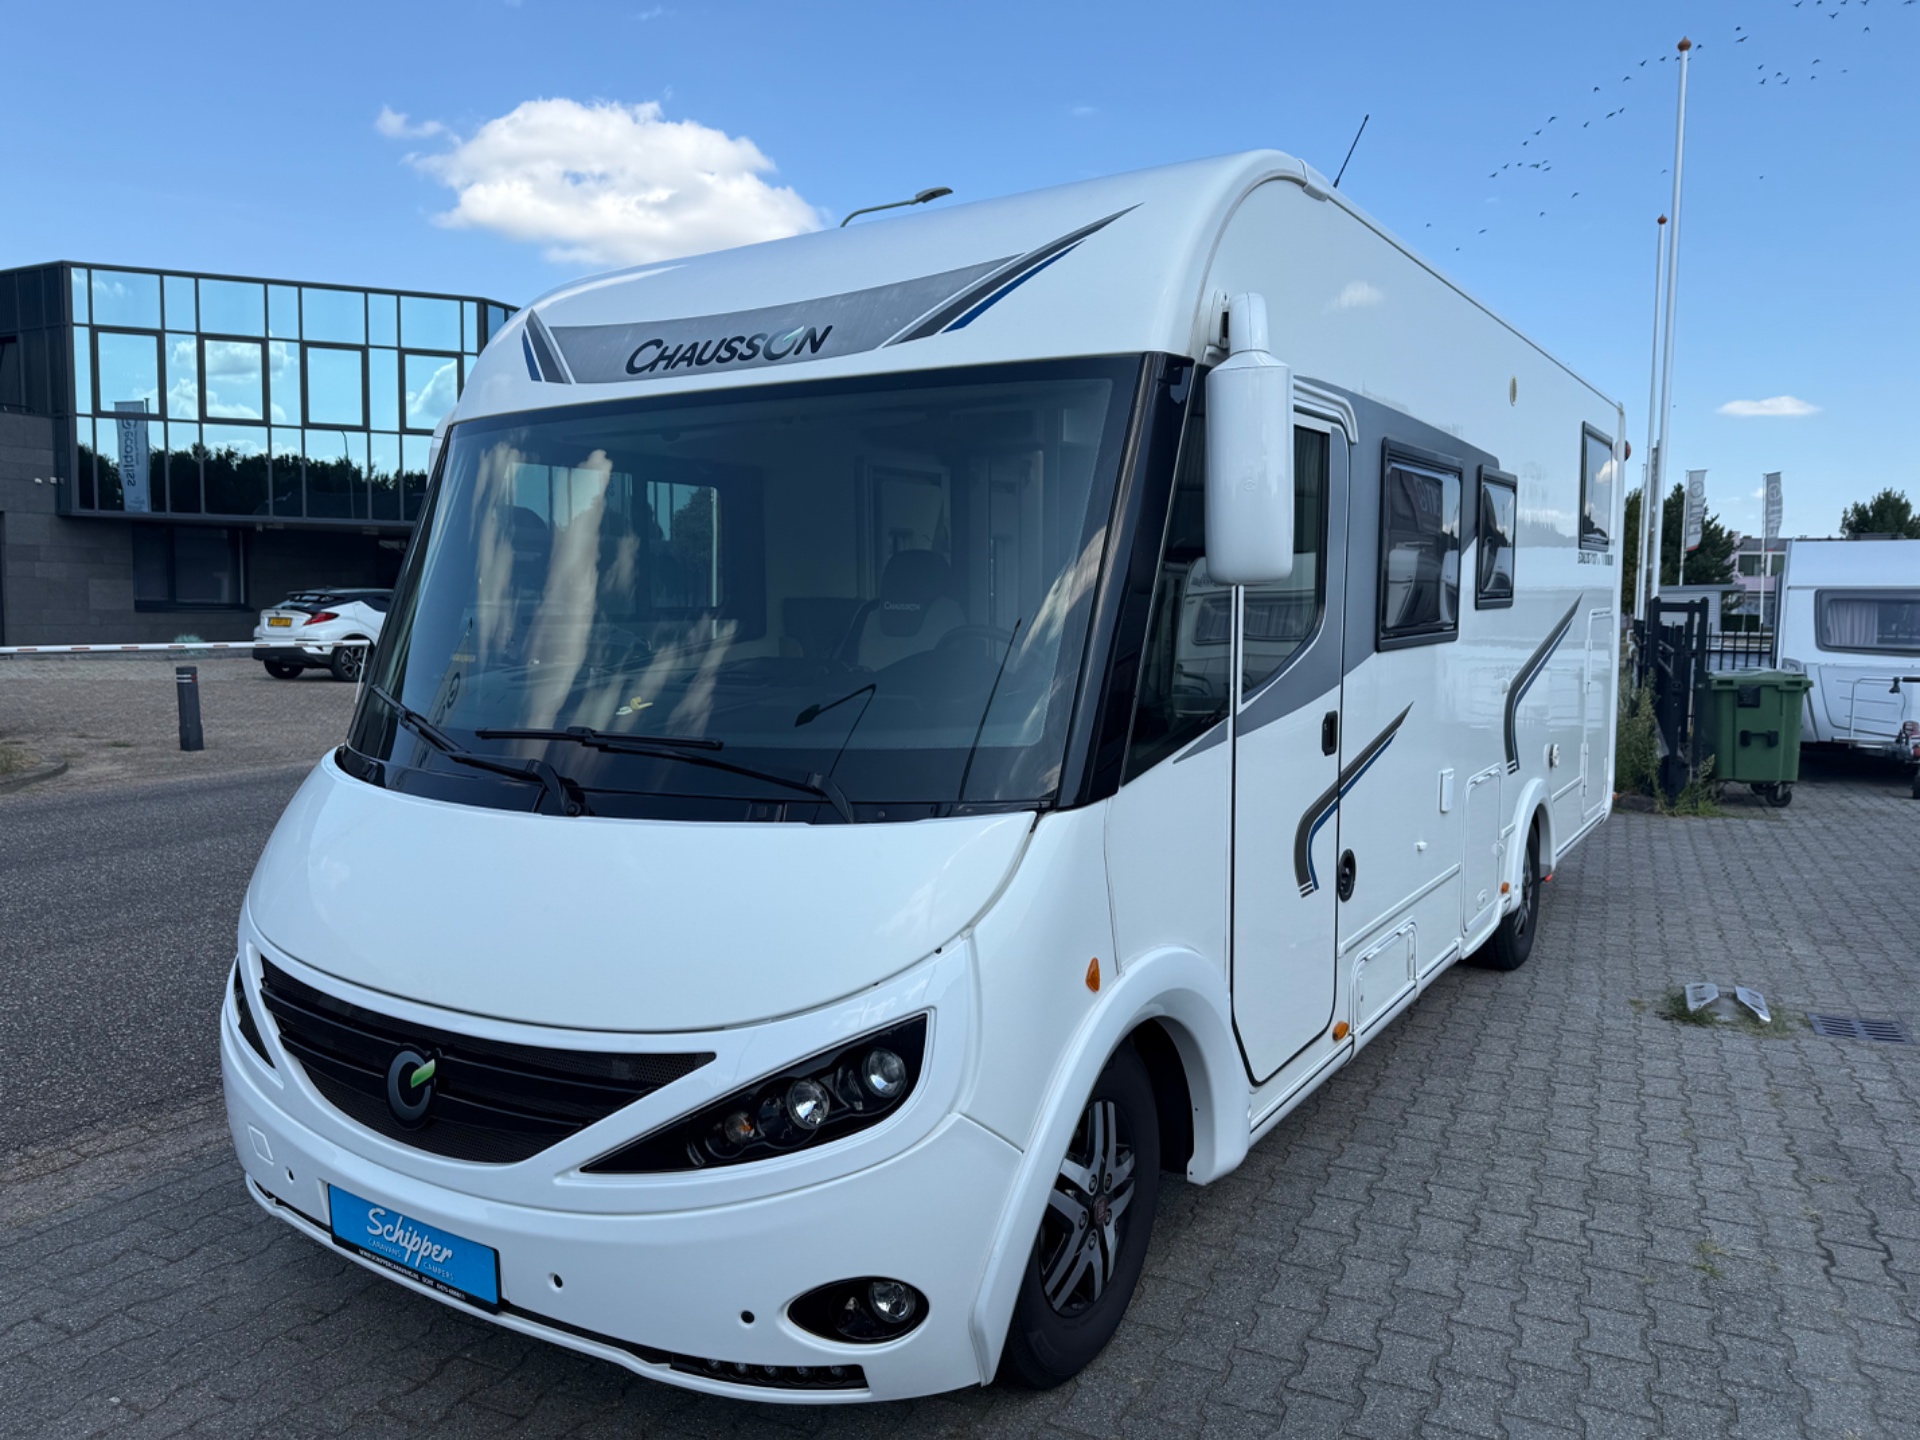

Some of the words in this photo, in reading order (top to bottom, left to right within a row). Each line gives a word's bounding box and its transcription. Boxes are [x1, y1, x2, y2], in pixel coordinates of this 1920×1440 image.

[625, 325, 832, 374] CHAUSSON
[366, 1207, 453, 1268] Schipper
[368, 1238, 402, 1258] CARAVANS
[423, 1261, 455, 1281] CAMPERS
